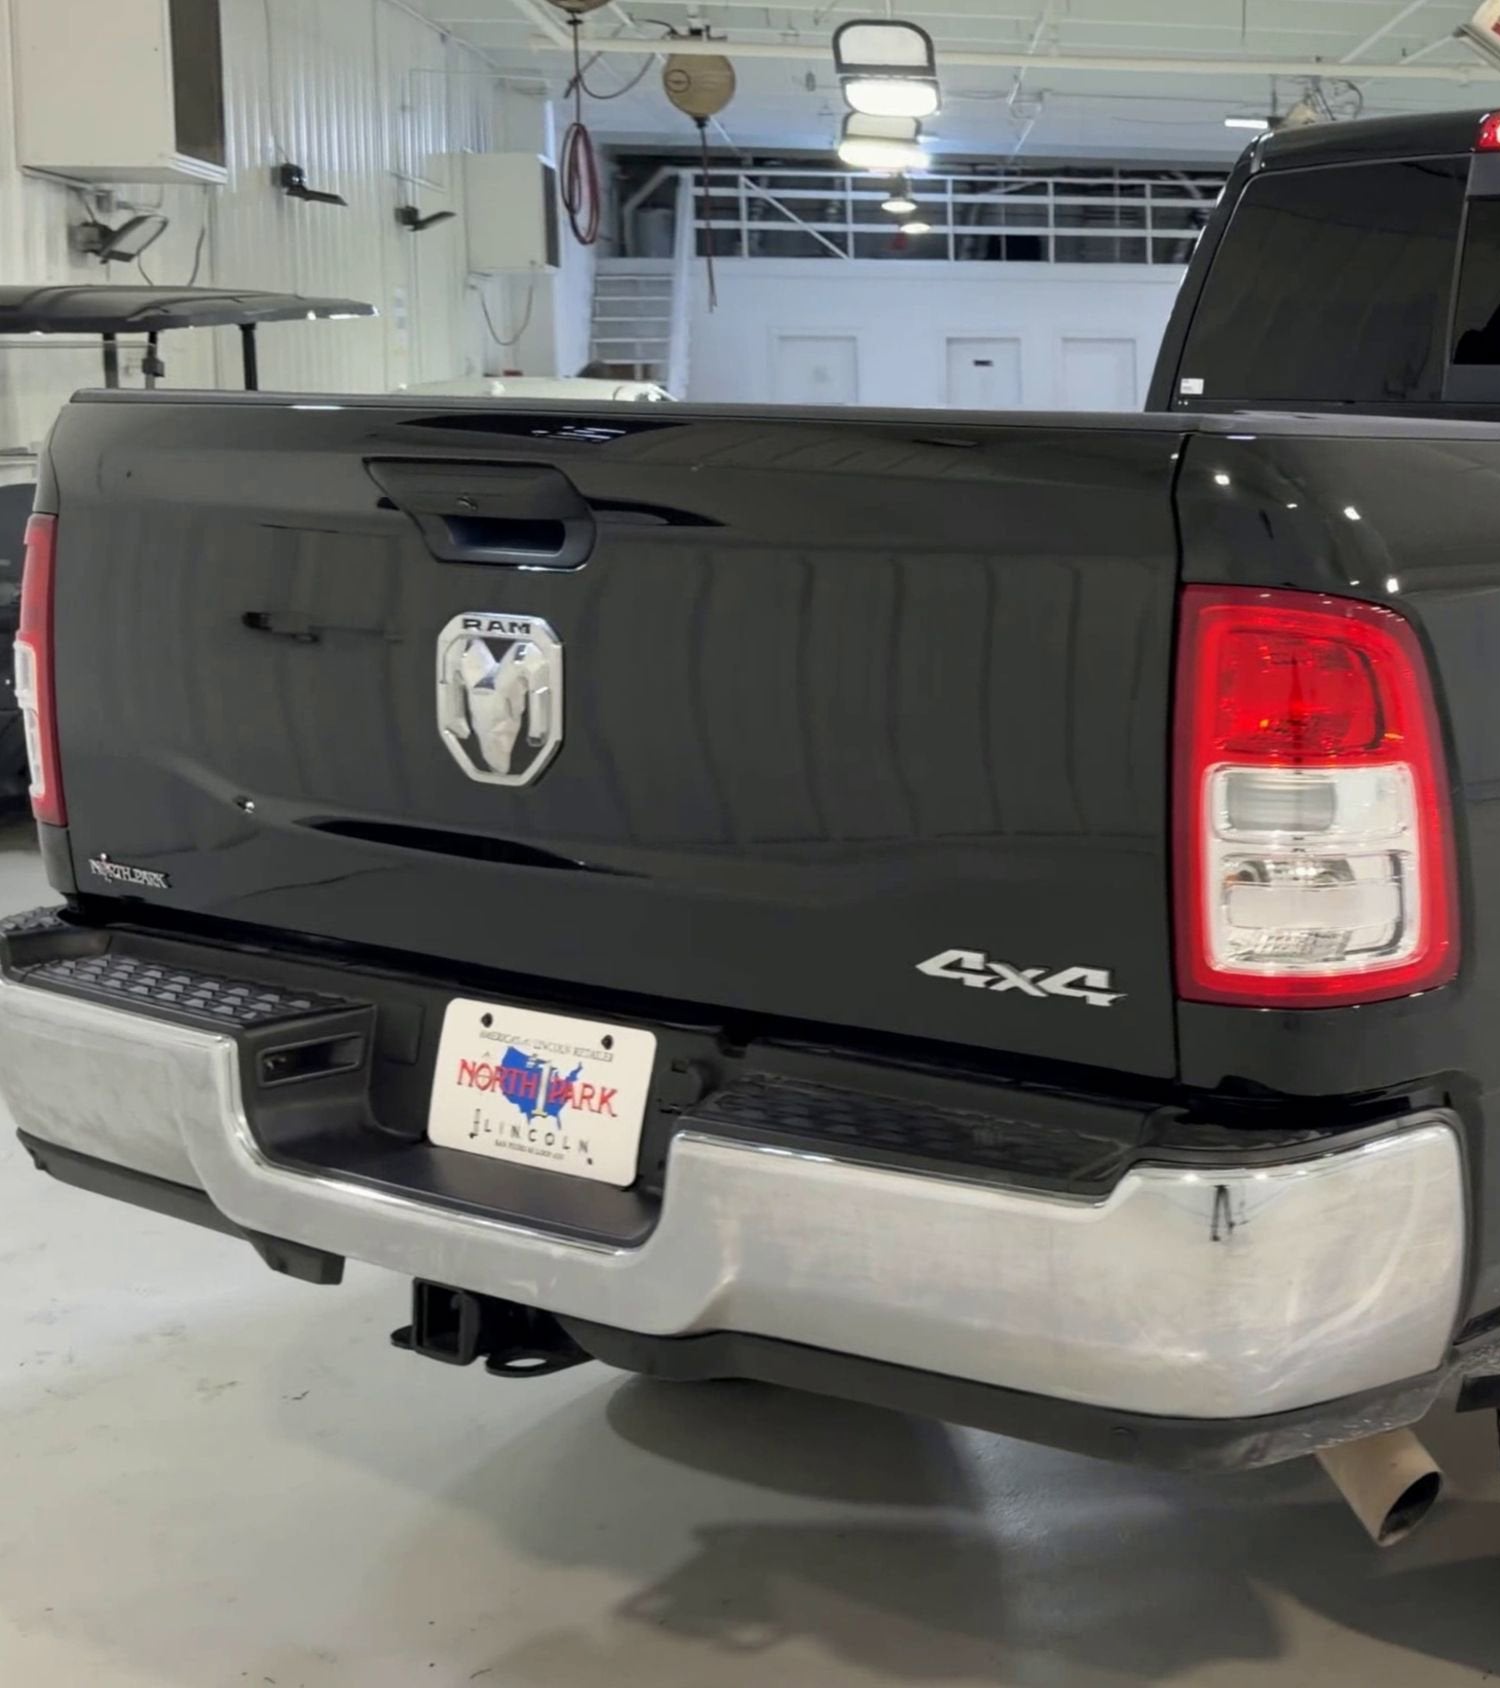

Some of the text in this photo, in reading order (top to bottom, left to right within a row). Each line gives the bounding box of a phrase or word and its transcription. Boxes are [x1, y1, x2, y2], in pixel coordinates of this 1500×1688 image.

[462, 618, 532, 635] RAM
[456, 1058, 619, 1118] NORTH PARK
[483, 1118, 590, 1154] LINCOLN
